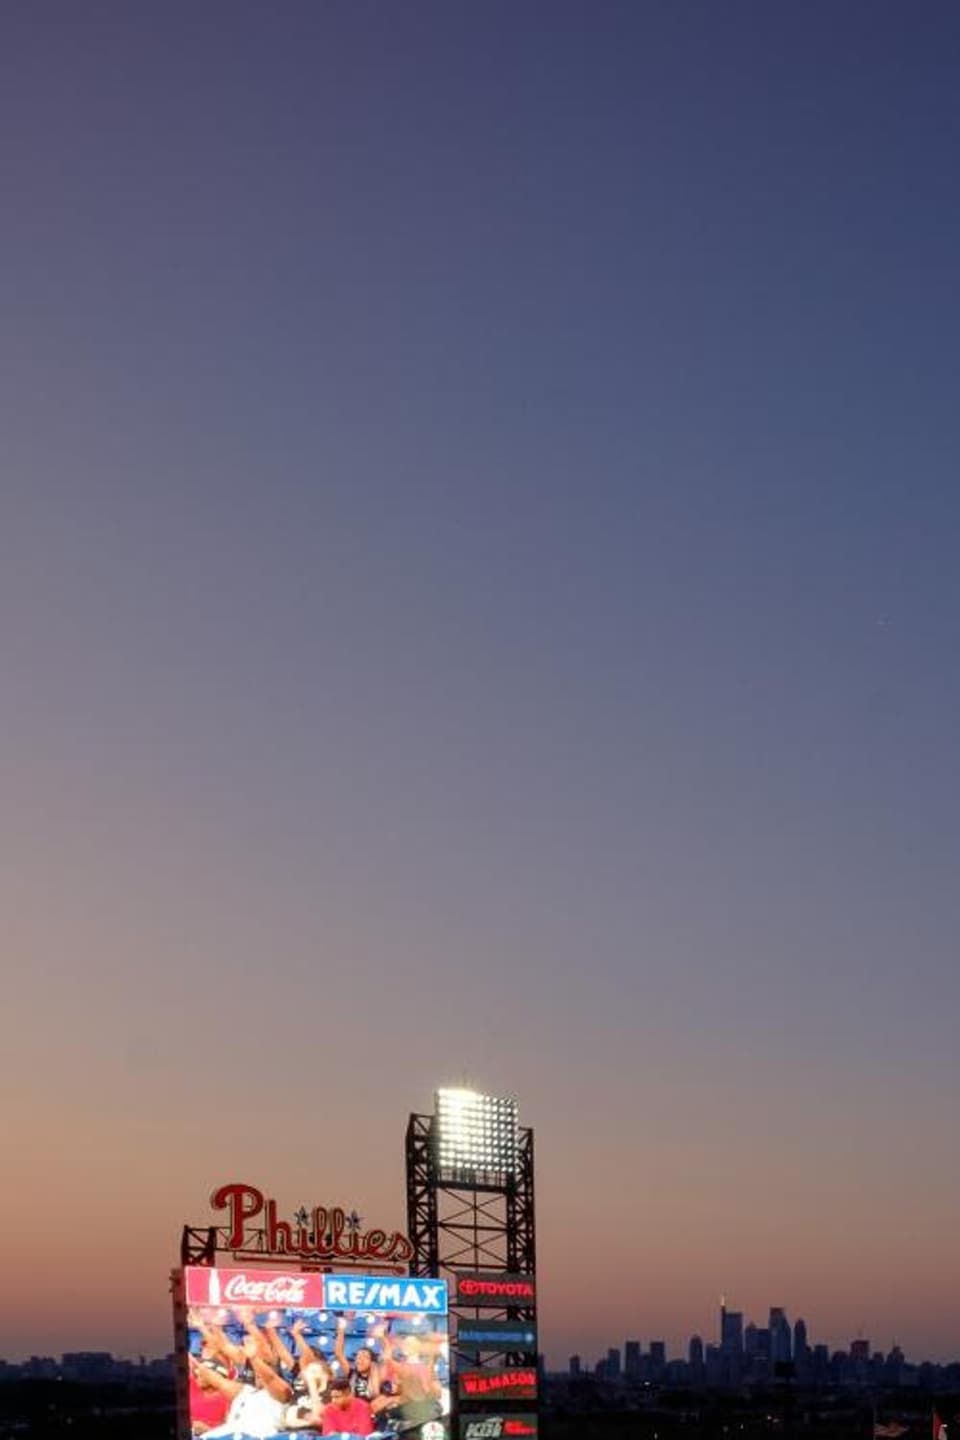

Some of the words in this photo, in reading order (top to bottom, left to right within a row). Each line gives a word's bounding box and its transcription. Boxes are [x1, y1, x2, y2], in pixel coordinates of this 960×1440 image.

[212, 1184, 415, 1261] Phillies
[327, 1281, 443, 1309] RE/MAX
[478, 1281, 533, 1296] TOYOTA
